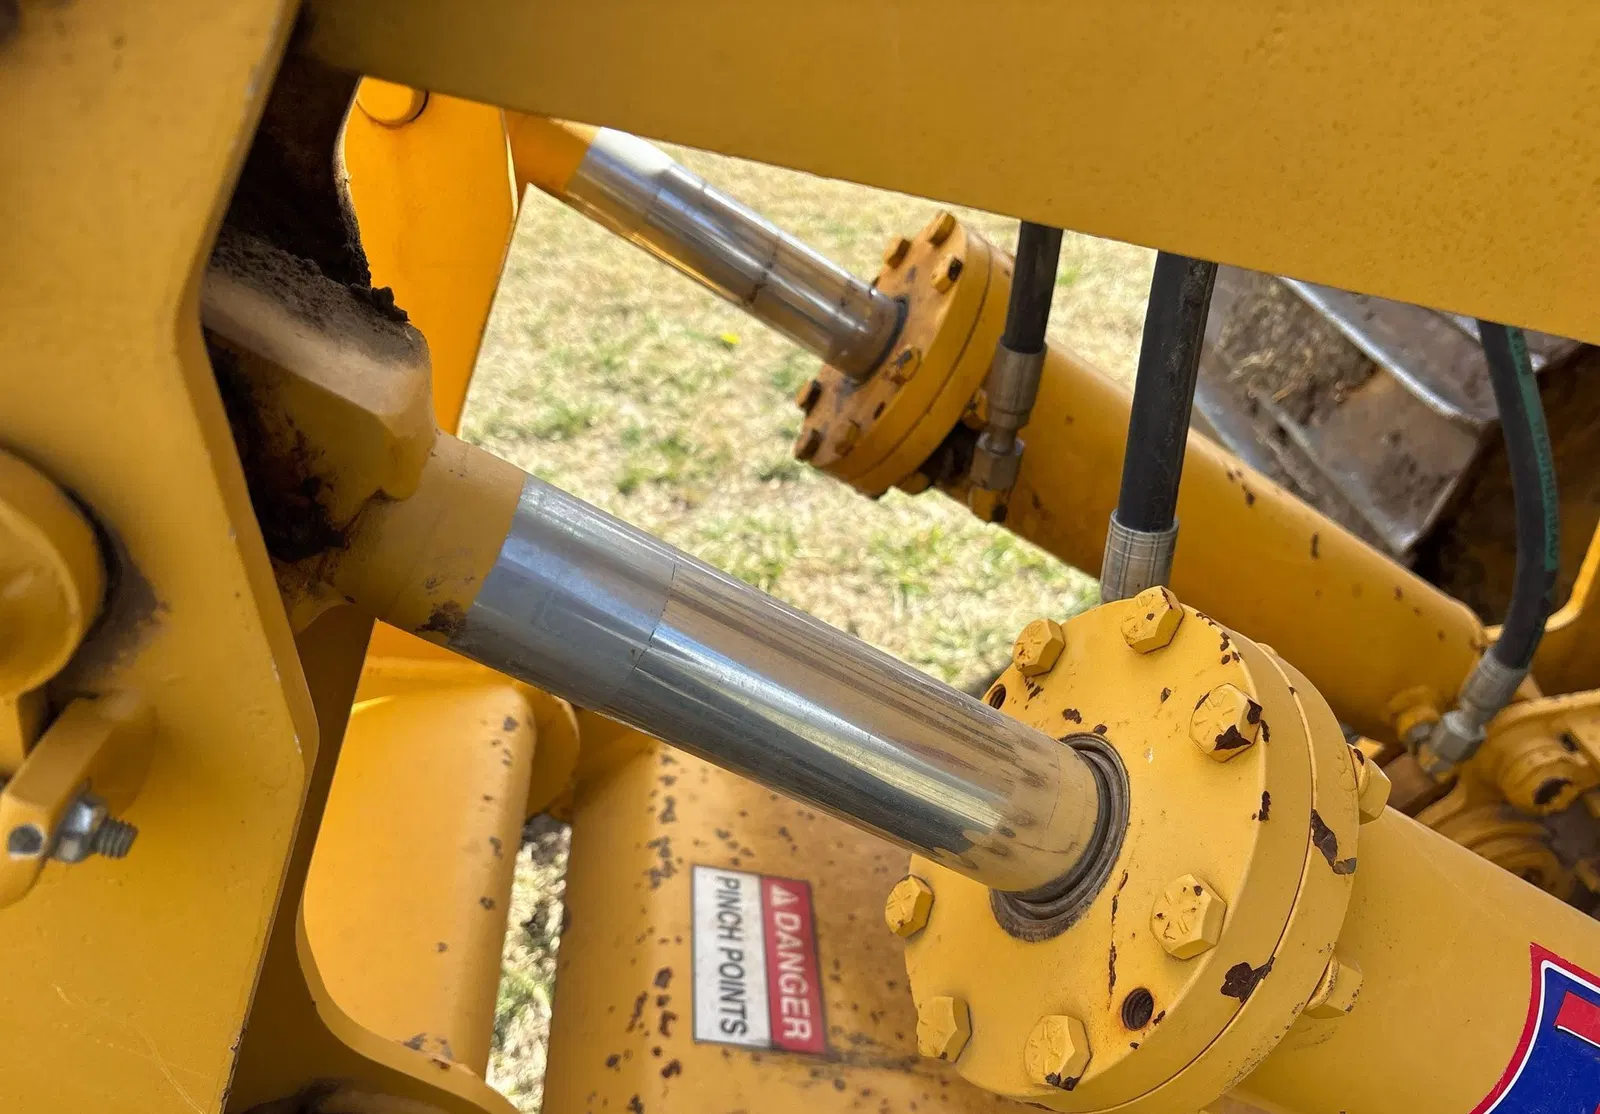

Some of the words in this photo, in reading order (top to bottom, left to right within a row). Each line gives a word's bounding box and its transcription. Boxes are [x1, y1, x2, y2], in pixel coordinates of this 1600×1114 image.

[714, 875, 742, 942] PINCH
[718, 947, 748, 1037] POINTS
[773, 911, 812, 1041] DANGER
